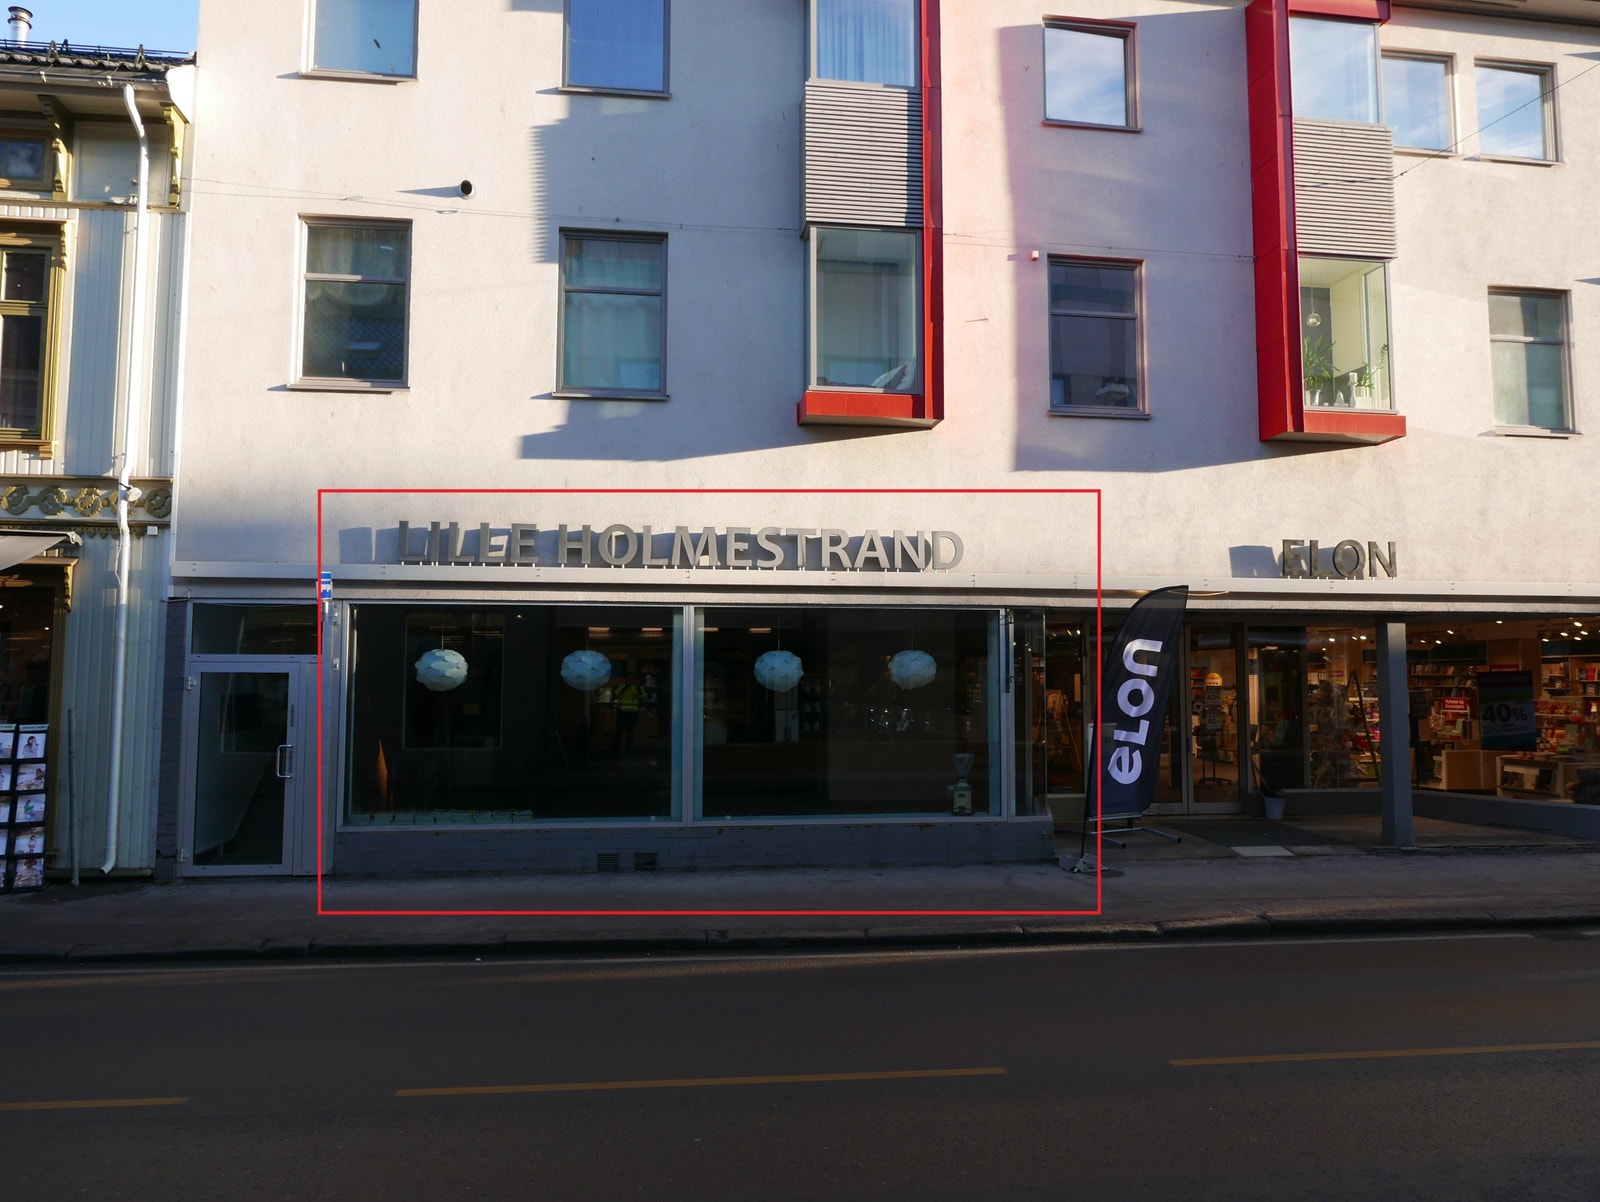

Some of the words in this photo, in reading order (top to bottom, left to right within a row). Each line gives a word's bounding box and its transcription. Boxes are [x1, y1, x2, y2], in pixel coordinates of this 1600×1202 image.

[399, 520, 538, 563] LILLE
[558, 523, 964, 570] HOLMESTRAND
[1281, 539, 1398, 578] ELON
[1482, 703, 1528, 723] 40%
